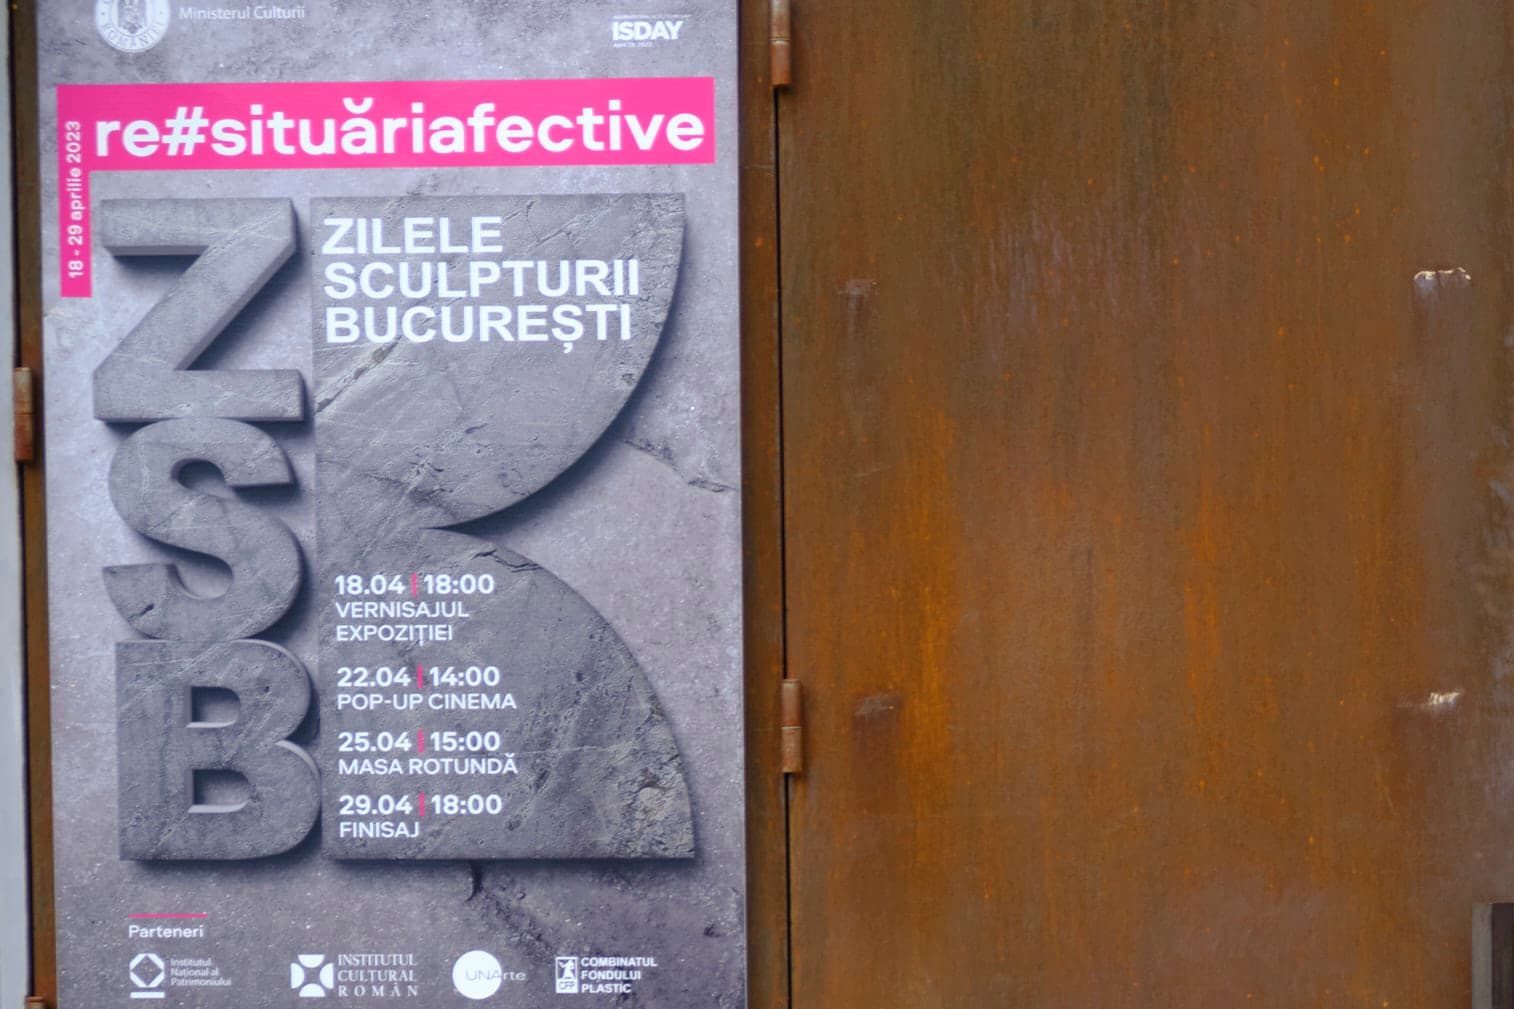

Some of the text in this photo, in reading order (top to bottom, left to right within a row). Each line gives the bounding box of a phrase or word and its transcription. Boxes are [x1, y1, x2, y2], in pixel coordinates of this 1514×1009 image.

[179, 5, 305, 20] Ministerul Culturii
[612, 20, 683, 41] ISDAY
[96, 97, 705, 158] re#situăriafective
[65, 121, 82, 164] 2023
[66, 167, 86, 221] aprilie
[68, 224, 83, 246] 29
[322, 215, 503, 255] ZILELE
[68, 260, 84, 278] 18
[323, 259, 640, 299] SCULPTURII
[325, 303, 632, 354] BUCUREȘTI
[334, 574, 495, 595] 18.04 18:00
[335, 601, 470, 618] VERNISAJUL
[336, 624, 453, 647] EXPOZIȚIEI
[337, 666, 501, 687] 22.04 14:00
[337, 693, 517, 710] POP-UP CINEMA
[338, 731, 501, 752] 25.04 15:00
[338, 752, 518, 775] MASA ROTUNDĂ
[339, 794, 503, 815] 29.04 18:00
[339, 821, 420, 838] FINISAJ
[128, 924, 204, 938] Parteneri
[338, 953, 418, 967] INSTITUTUL
[580, 956, 658, 967] COMBINATUL
[337, 969, 417, 982] CULTURAL
[581, 970, 642, 980] FONDULUI
[581, 983, 632, 993] PLASTIC
